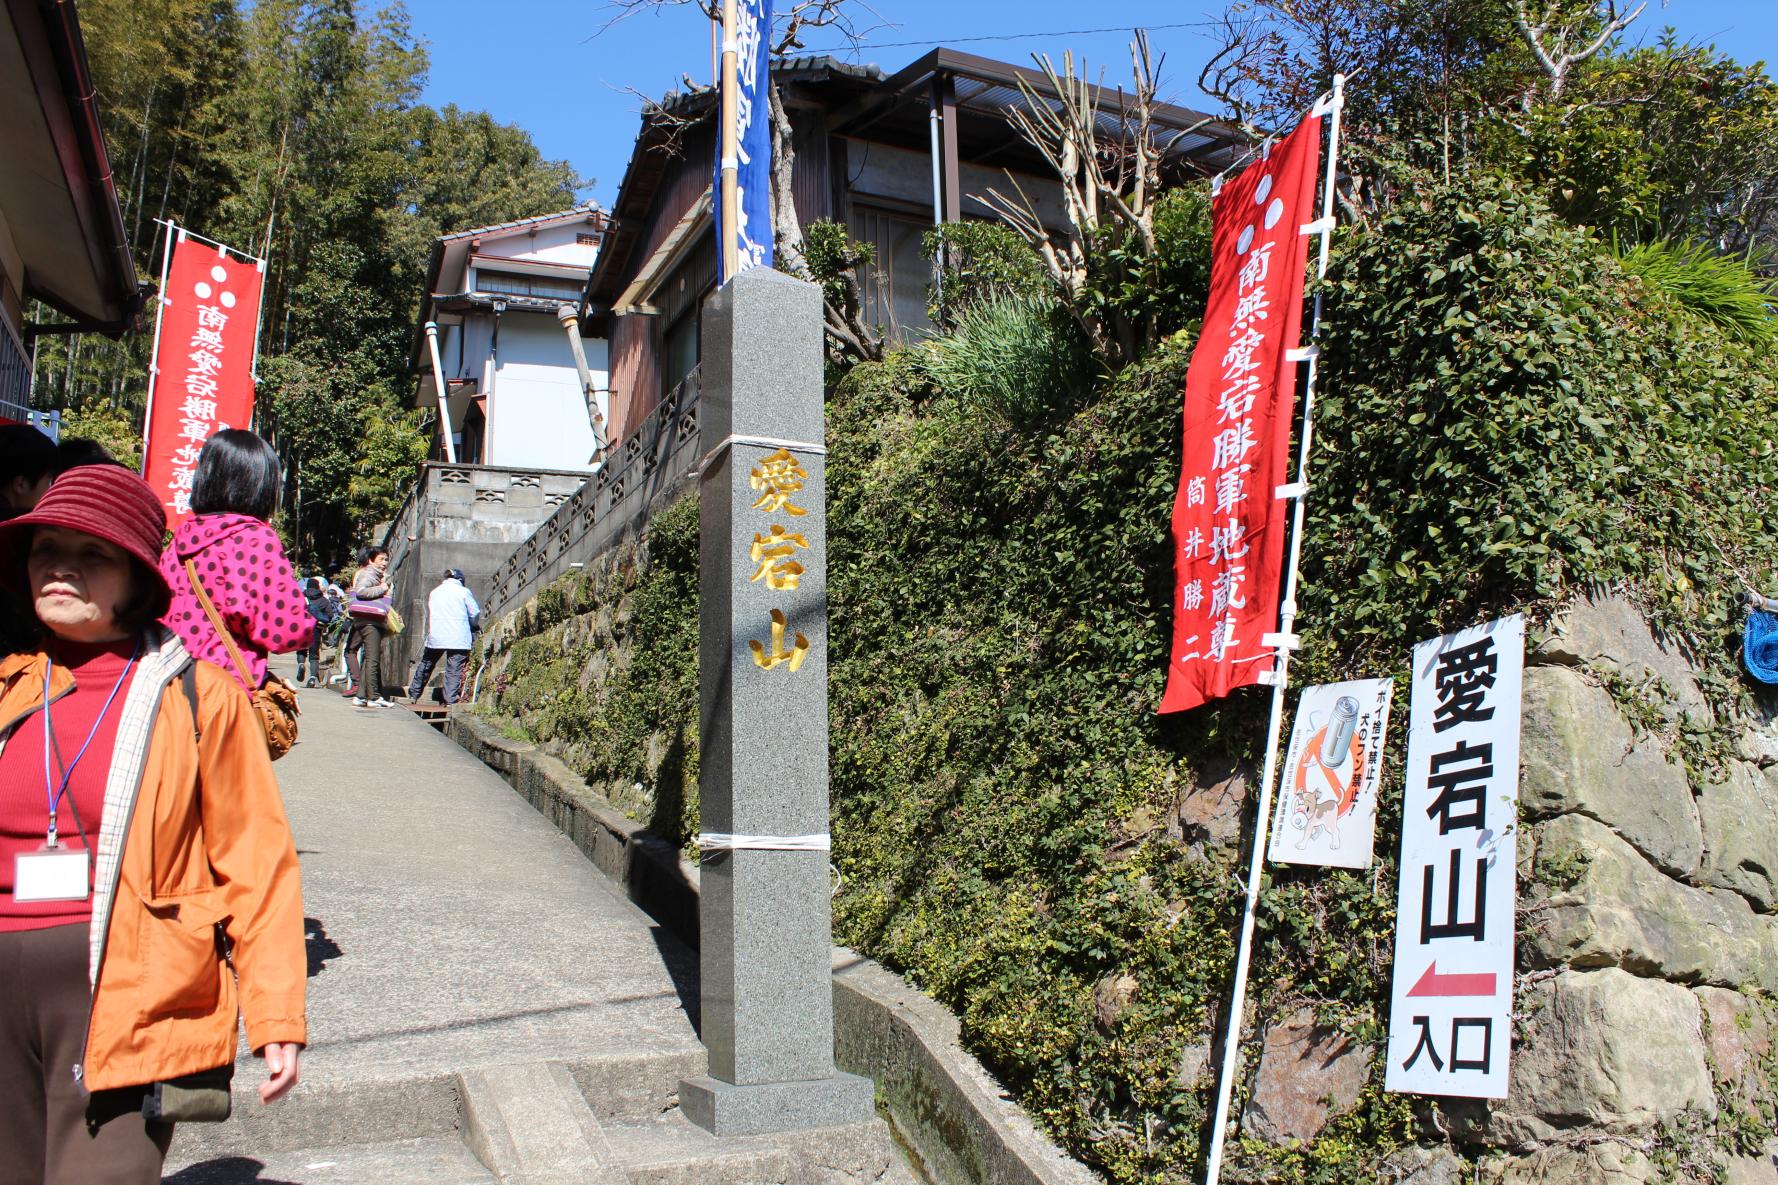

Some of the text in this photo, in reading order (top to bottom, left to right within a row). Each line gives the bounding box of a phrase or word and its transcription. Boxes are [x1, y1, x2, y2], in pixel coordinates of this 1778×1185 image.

[748, 447, 811, 673] 愛宕山
[1202, 241, 1272, 663] 南無愛宕勝軍地蔵尊
[1181, 478, 1206, 663] 筒井勝二
[1419, 635, 1498, 945] 愛宕山
[1402, 1015, 1493, 1074] 入口
